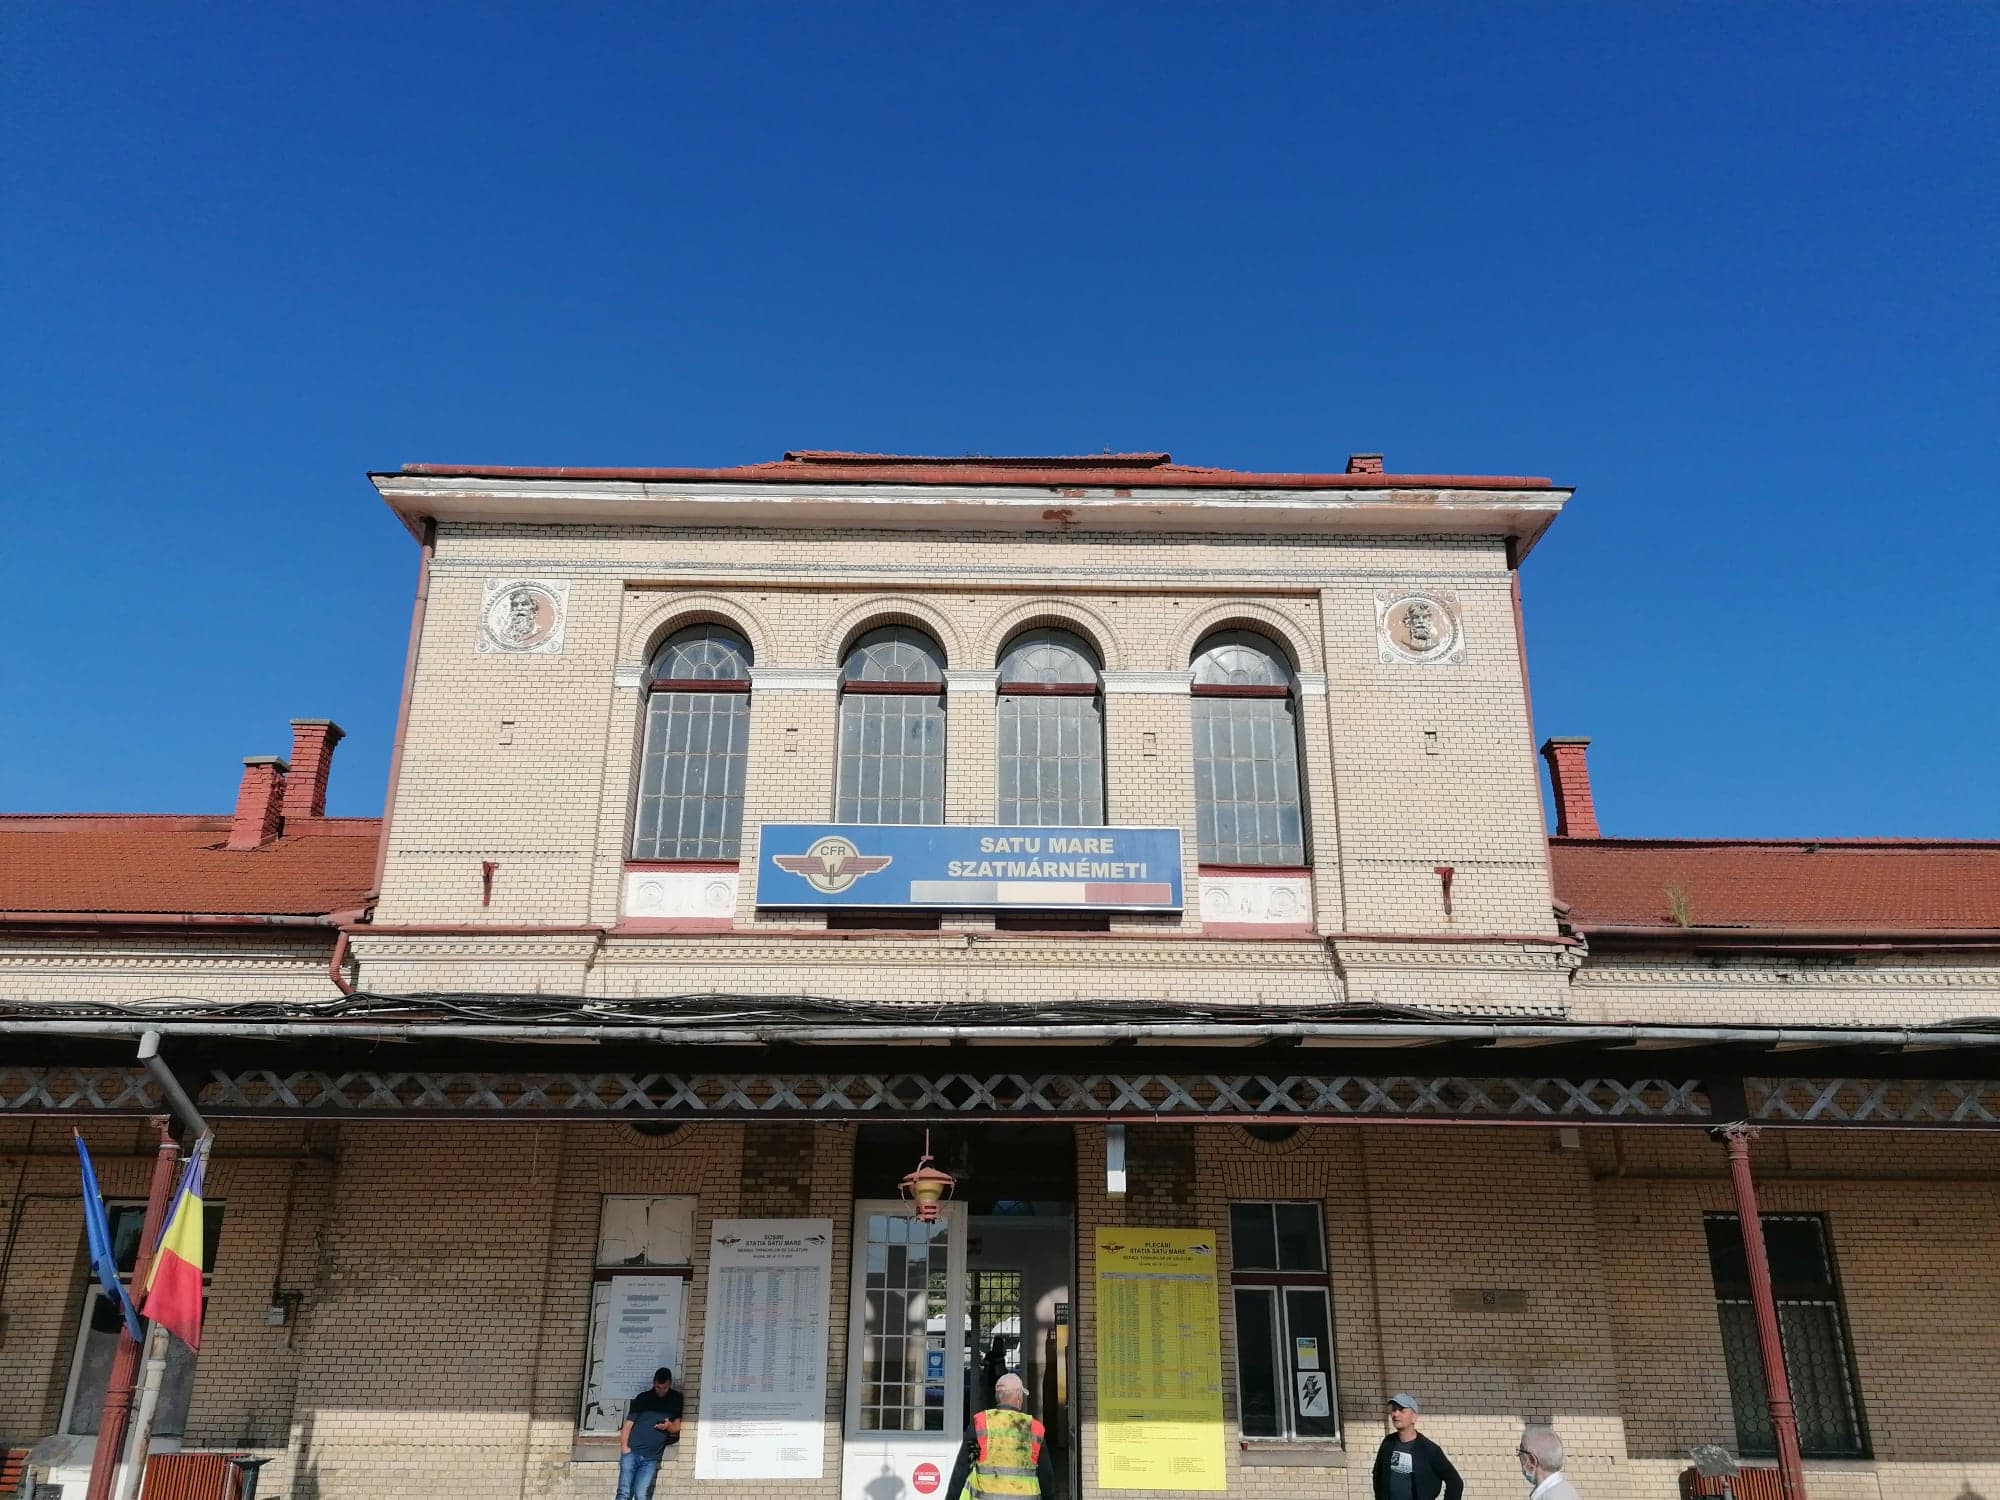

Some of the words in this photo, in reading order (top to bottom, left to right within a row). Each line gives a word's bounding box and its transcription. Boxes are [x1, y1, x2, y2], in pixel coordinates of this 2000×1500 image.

[820, 846, 846, 856] CFR
[980, 837, 1041, 853] SATU
[1048, 838, 1115, 854] MARE
[947, 857, 1147, 879] SZATMÁRNÉMETI
